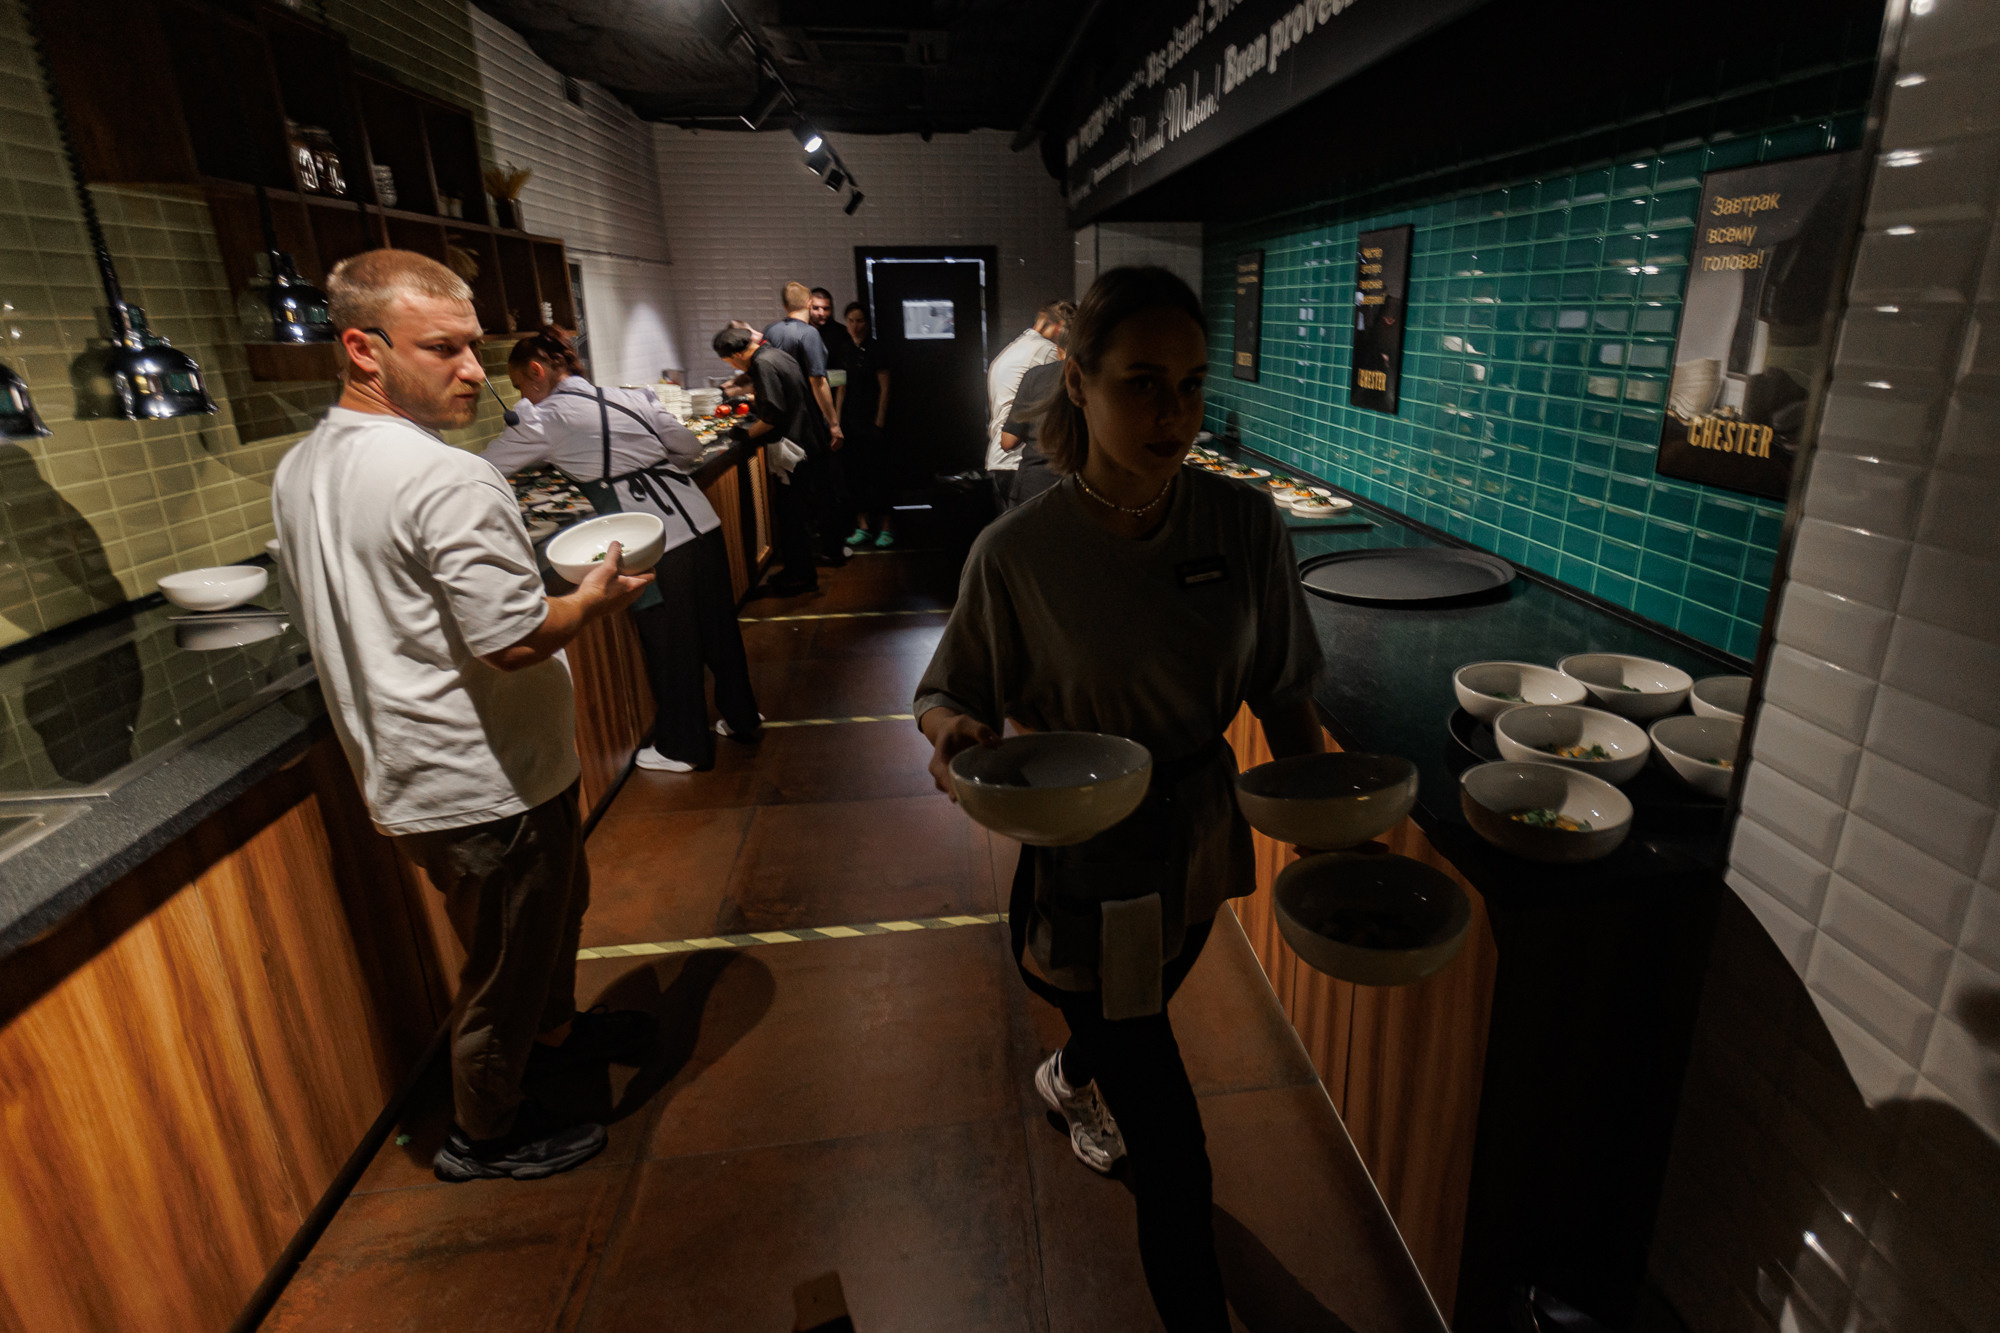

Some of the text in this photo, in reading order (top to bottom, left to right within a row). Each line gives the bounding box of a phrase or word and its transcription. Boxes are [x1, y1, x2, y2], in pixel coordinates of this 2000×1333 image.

[1223, 33, 1267, 94] Buen
[1710, 192, 1781, 217] Завтрак
[1705, 225, 1758, 247] всему
[1701, 248, 1765, 271] голова!
[1687, 416, 1774, 459] CHESTER
